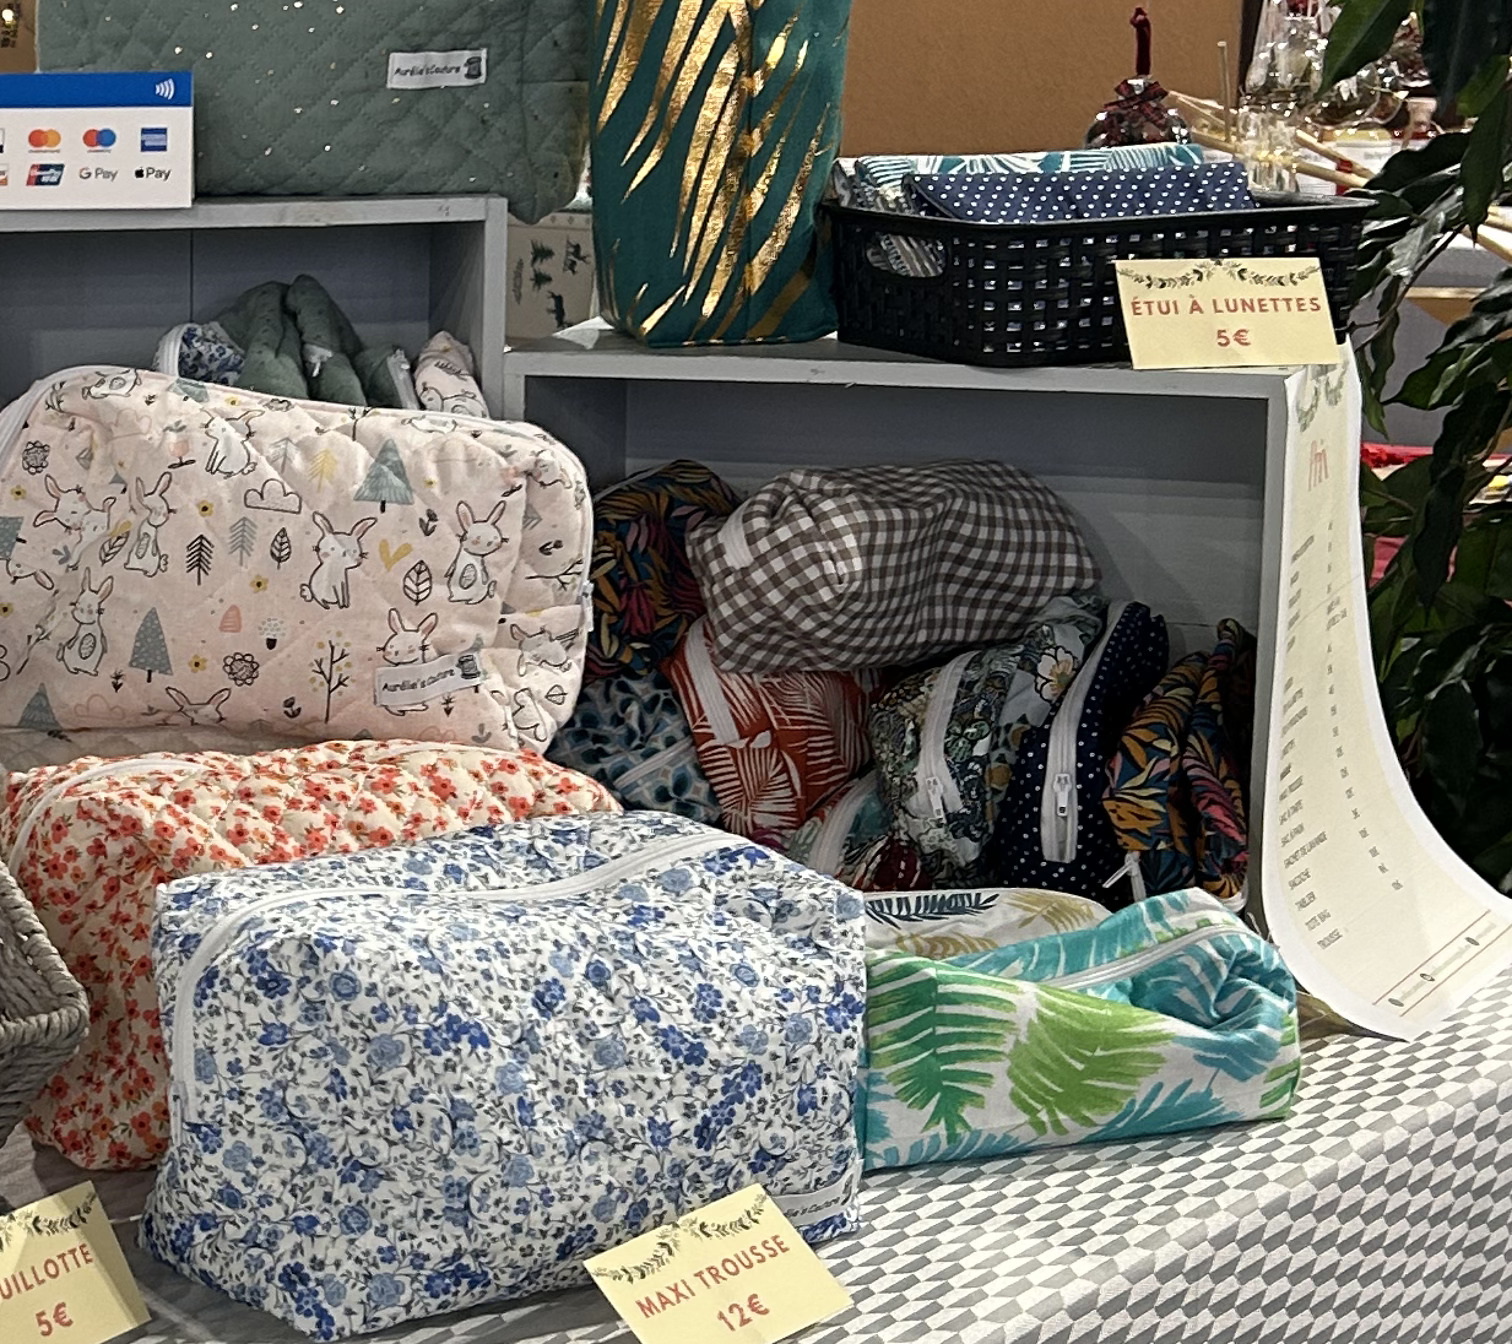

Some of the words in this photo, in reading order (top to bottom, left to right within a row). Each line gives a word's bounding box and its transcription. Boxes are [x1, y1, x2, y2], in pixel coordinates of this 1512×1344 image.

[95, 167, 118, 181] Pay
[146, 167, 171, 181] Pay
[1131, 296, 1179, 316] ÉTUI
[1189, 294, 1204, 314] À
[1212, 297, 1321, 314] LUNETTES
[1217, 329, 1251, 347] 5€
[635, 1278, 696, 1318] MAXI
[694, 1234, 790, 1289] TROUSSE
[36, 1301, 74, 1337] 5€
[717, 1293, 770, 1332] 12€
